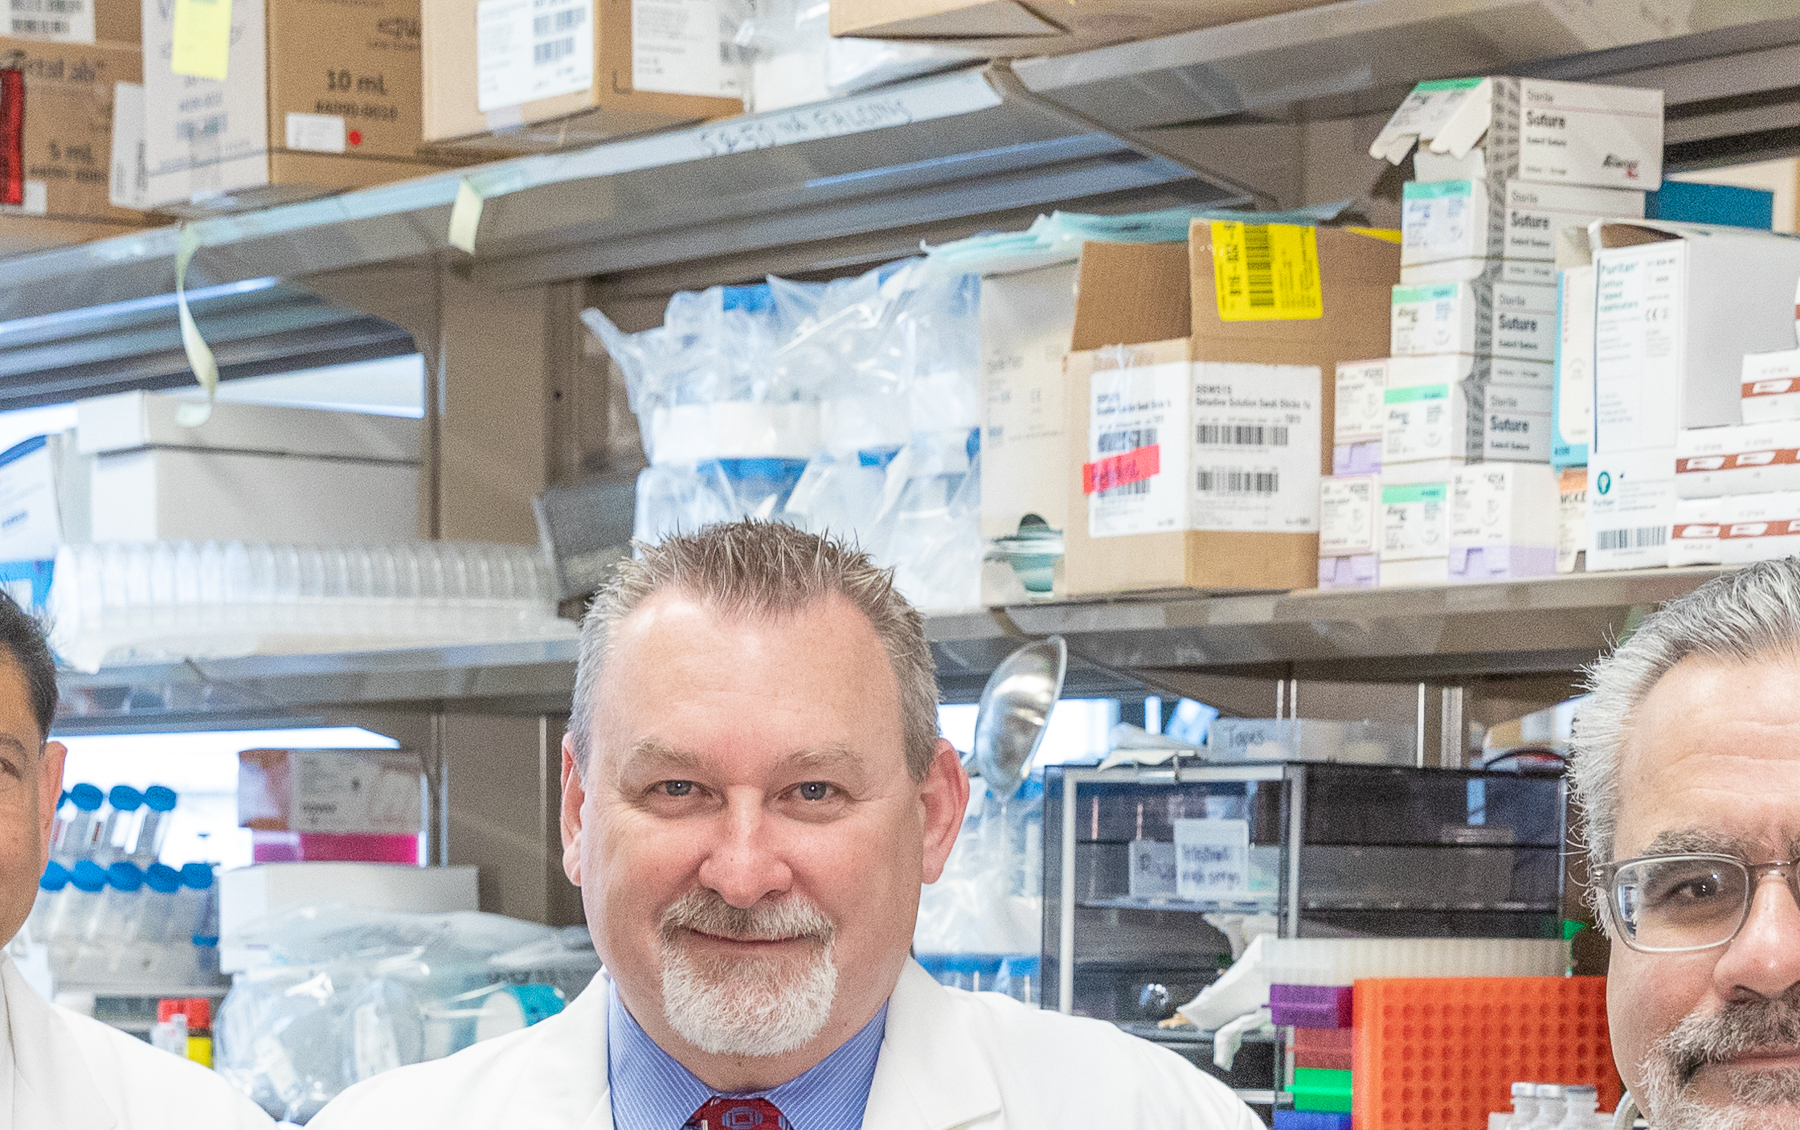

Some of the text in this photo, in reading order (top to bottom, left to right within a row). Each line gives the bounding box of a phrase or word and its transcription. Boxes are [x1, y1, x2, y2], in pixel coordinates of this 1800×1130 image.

[1526, 111, 1566, 129] Suture
[1511, 211, 1550, 230] Suture
[1499, 314, 1538, 332] Suture
[1490, 415, 1529, 432] Suture
